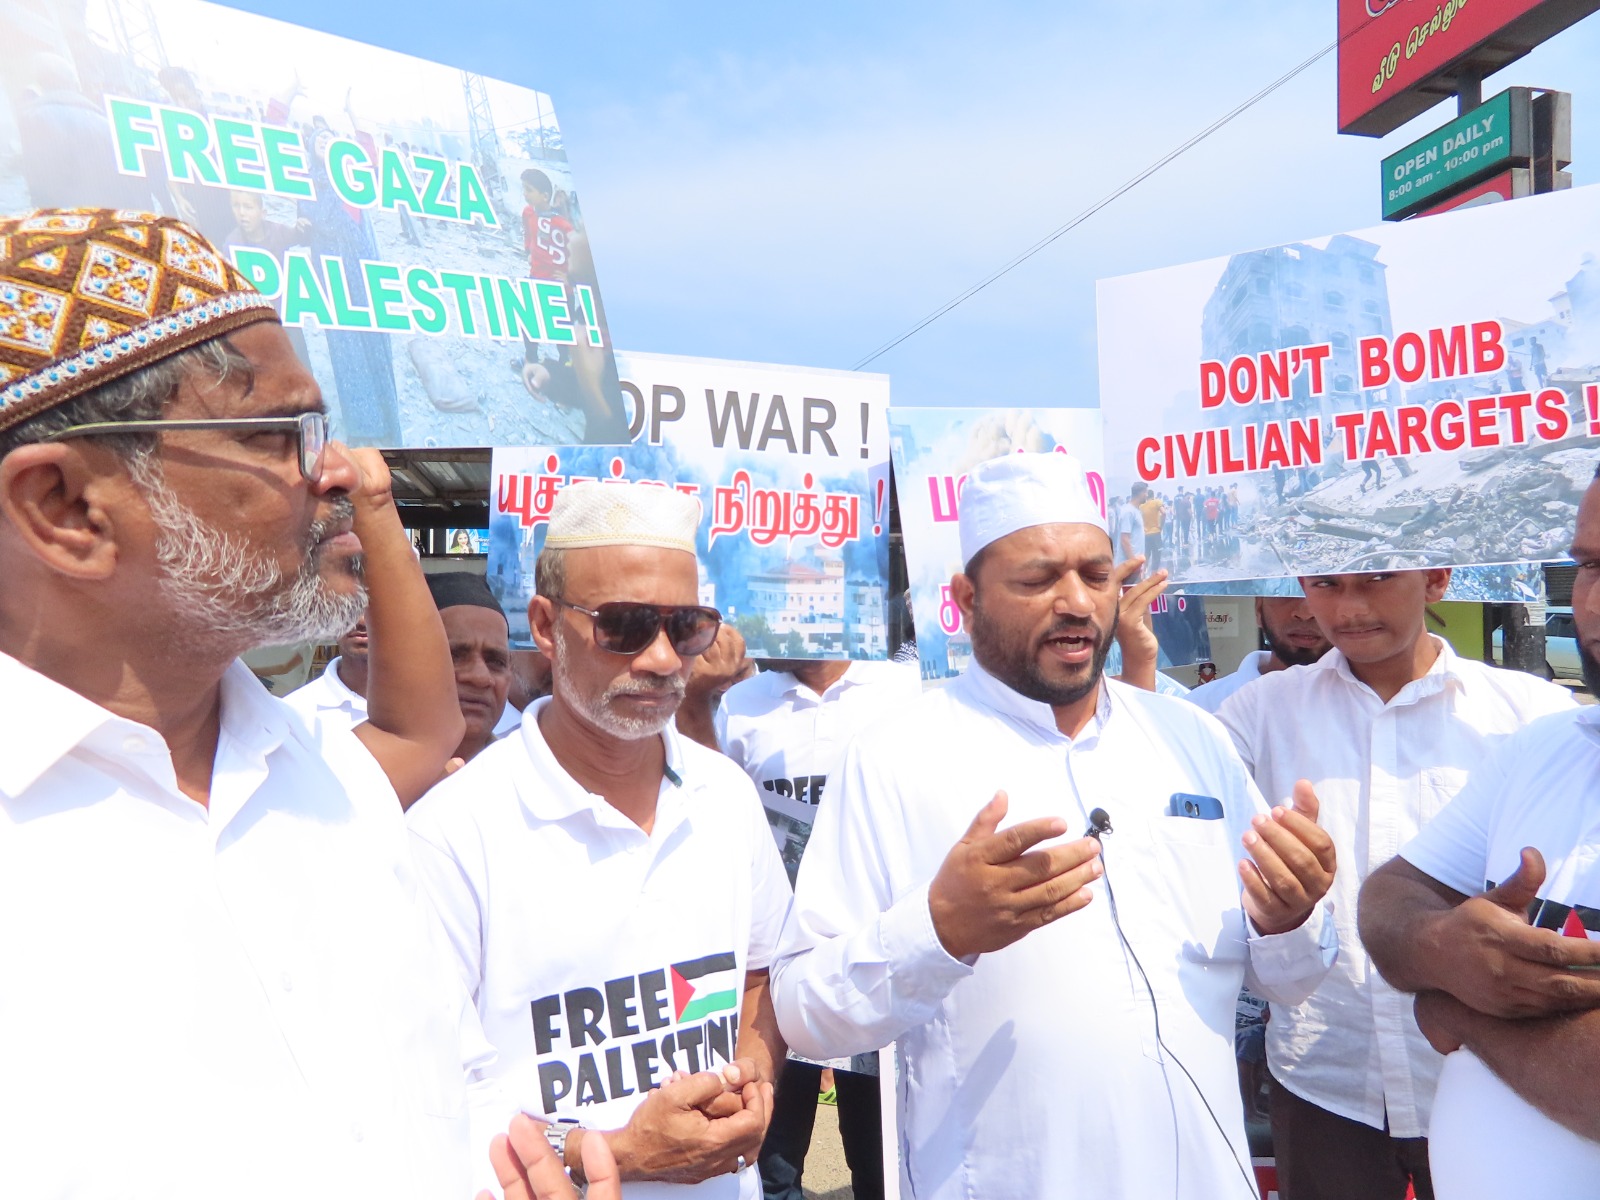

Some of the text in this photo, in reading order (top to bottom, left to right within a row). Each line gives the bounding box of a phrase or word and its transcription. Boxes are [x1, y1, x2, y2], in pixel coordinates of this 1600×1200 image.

[1405, 0, 1468, 60] செல்லு
[110, 99, 497, 226] FREE GAZA
[1388, 181, 1413, 201] 8:00
[1415, 172, 1433, 188] am
[1444, 146, 1479, 172] 10:00
[1483, 136, 1503, 156] pm
[1394, 113, 1494, 181] OPEN DAILY
[233, 249, 577, 343] PALESTINE
[1360, 320, 1506, 388] BOMB
[704, 388, 839, 457] WAR
[1136, 418, 1321, 481] CIVILIAN
[1335, 389, 1569, 460] TARGETS
[711, 470, 858, 548] நிறுத்து
[531, 968, 670, 1055] FREE
